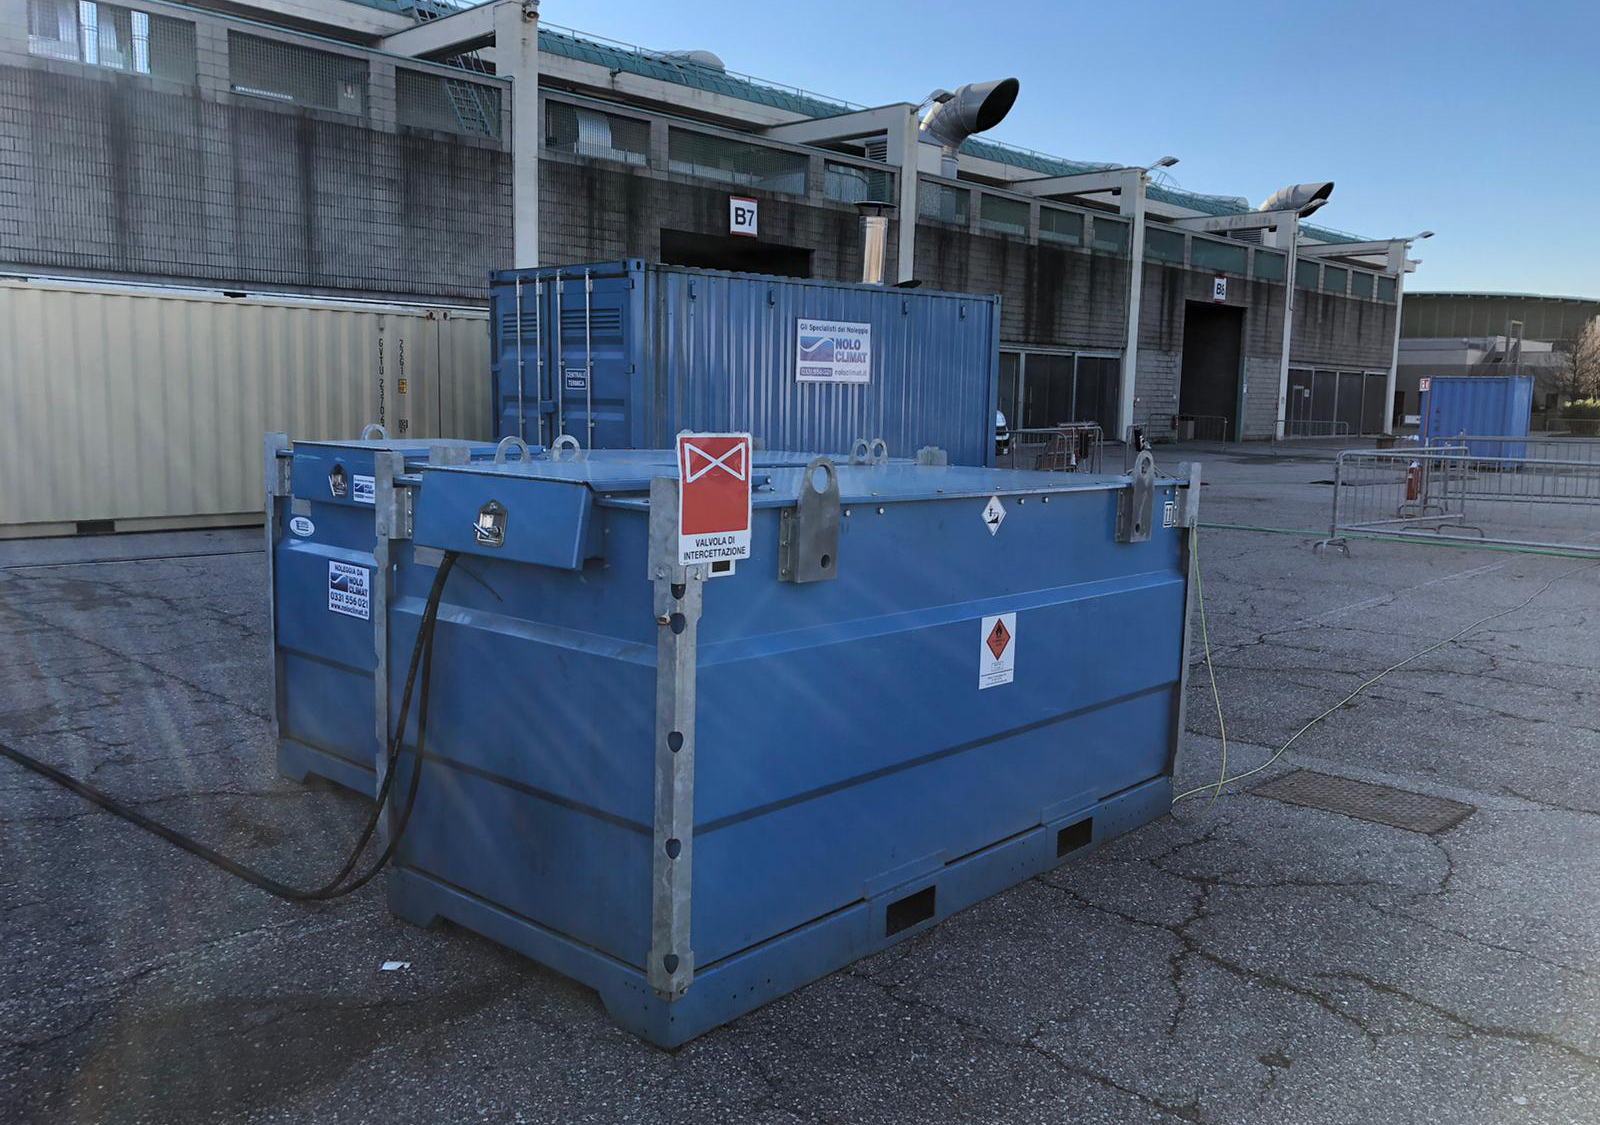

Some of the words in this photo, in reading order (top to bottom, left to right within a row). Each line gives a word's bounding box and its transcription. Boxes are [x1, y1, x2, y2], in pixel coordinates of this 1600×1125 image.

[735, 206, 755, 226] B7
[1216, 283, 1225, 295] B6
[800, 323, 808, 331] Gli
[809, 324, 836, 333] Specialisti
[847, 326, 868, 335] Noleggio
[835, 338, 861, 350] NOLO
[835, 351, 868, 363] CLIMAT
[695, 537, 727, 547] VALVOLA
[727, 535, 736, 545] DI
[684, 546, 746, 560] INTERCETTAZIONE
[335, 564, 356, 575] NOLEGGIA
[349, 577, 363, 587] NOLO
[331, 591, 344, 602] 0331
[349, 586, 368, 597] CLIMAT
